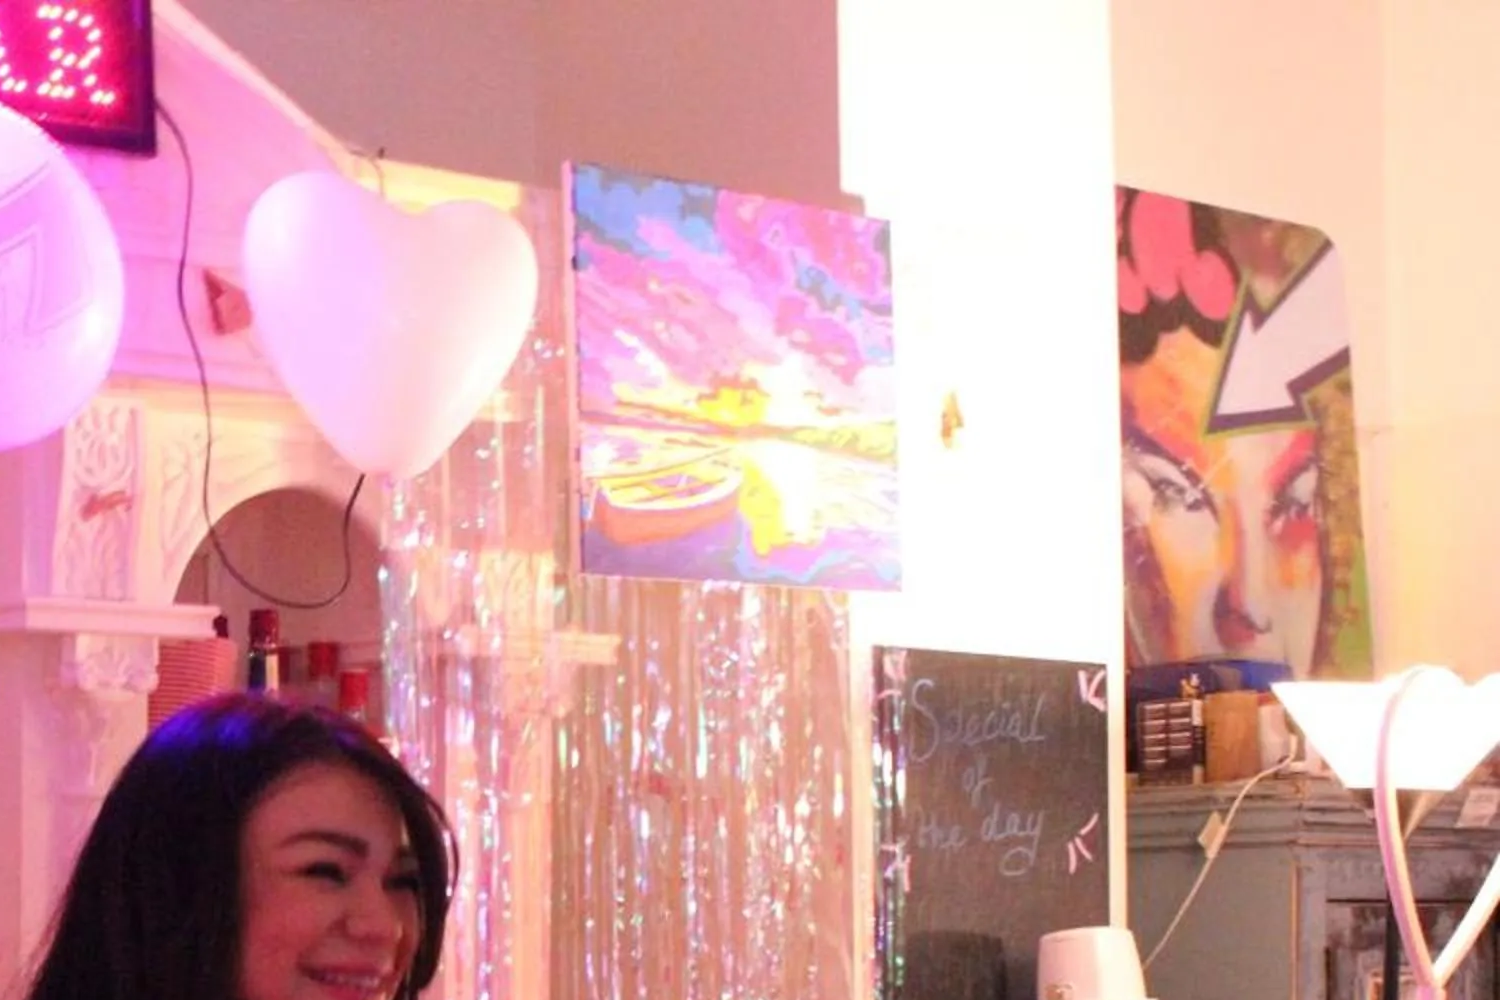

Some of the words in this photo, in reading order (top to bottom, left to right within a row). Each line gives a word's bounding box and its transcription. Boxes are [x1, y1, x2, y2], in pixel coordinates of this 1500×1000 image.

[910, 678, 1046, 763] Special
[961, 753, 995, 806] of
[918, 808, 969, 850] the
[981, 803, 1045, 877] day
